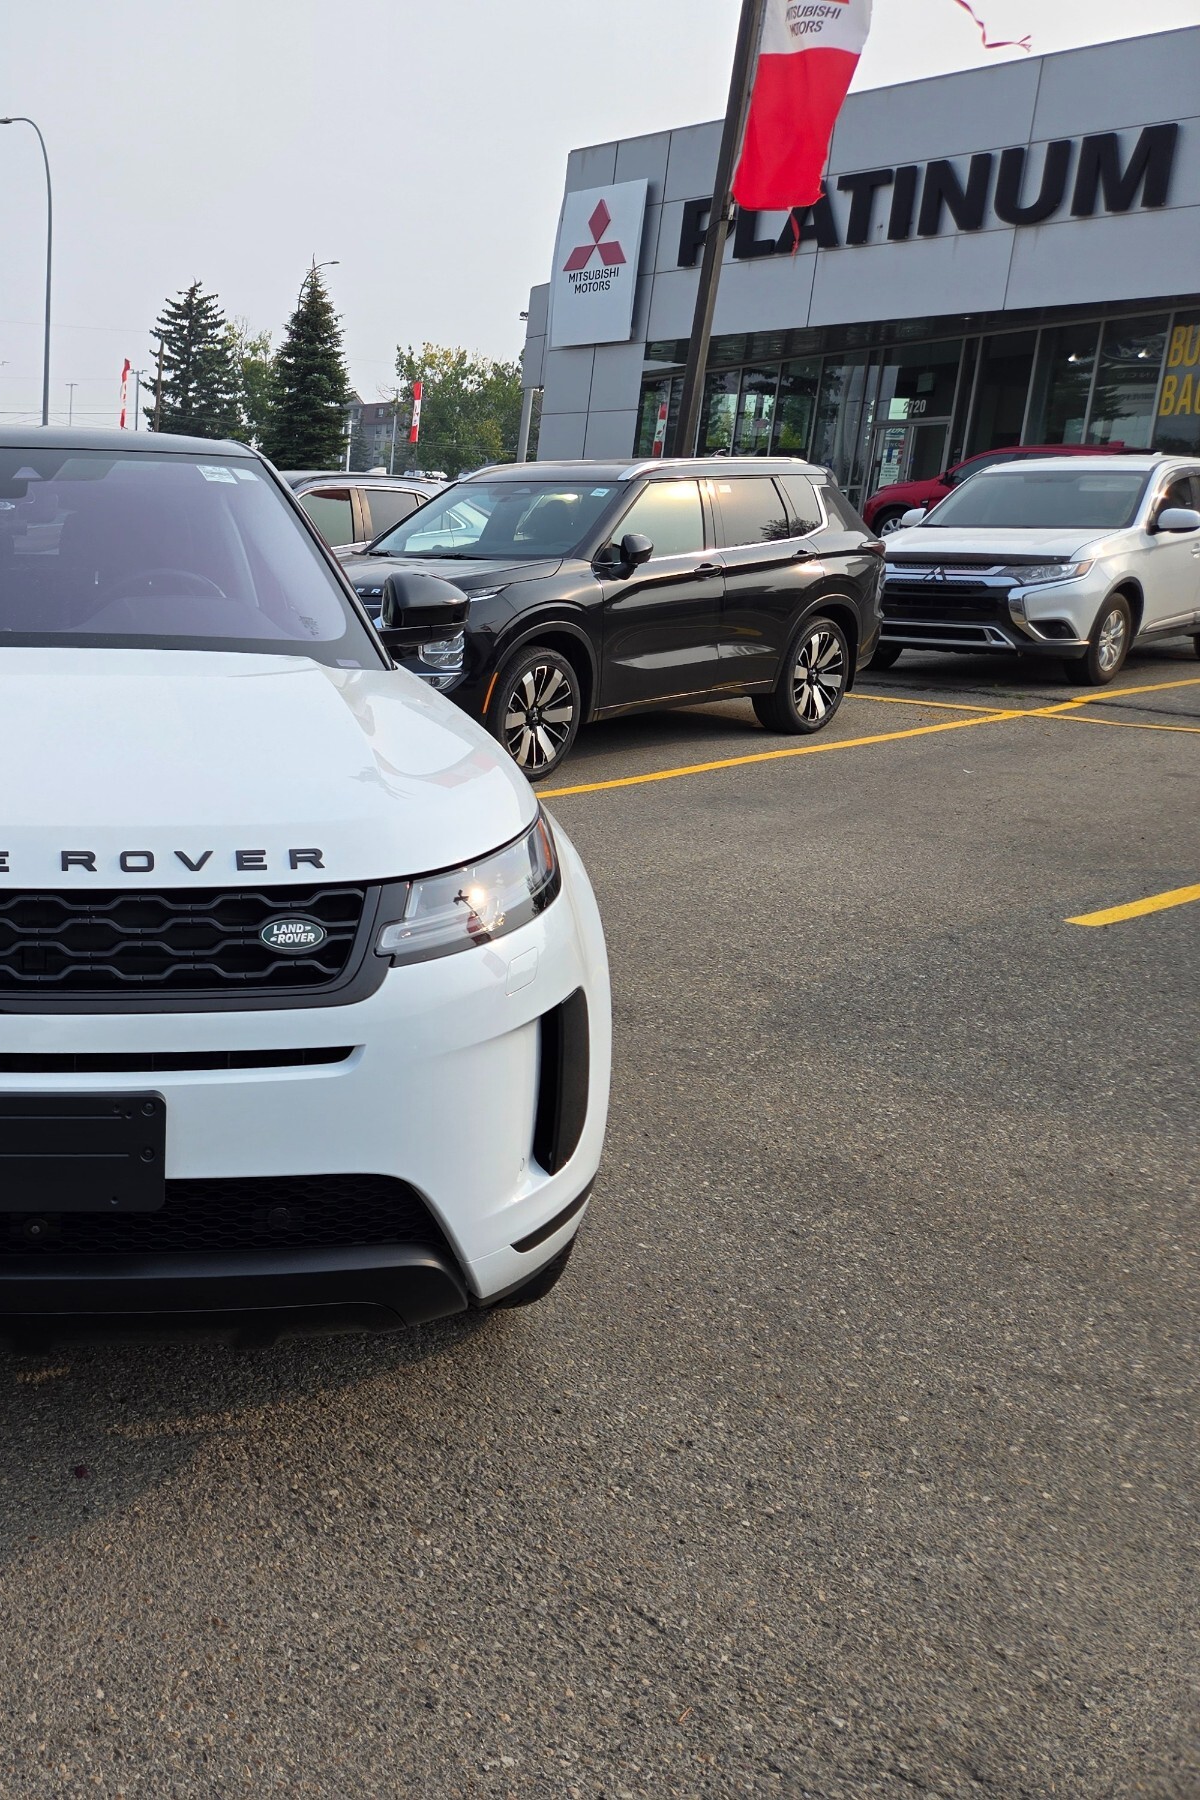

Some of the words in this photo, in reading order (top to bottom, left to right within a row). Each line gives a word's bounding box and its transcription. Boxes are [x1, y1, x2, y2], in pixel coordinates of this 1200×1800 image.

[677, 122, 1179, 268] PLATINUM
[568, 267, 620, 283] MITSUBISHI
[574, 280, 611, 294] MOTORS
[903, 399, 927, 414] 2720
[61, 848, 326, 873] ROVER
[273, 924, 304, 935] LAND
[277, 932, 316, 944] ROVER
